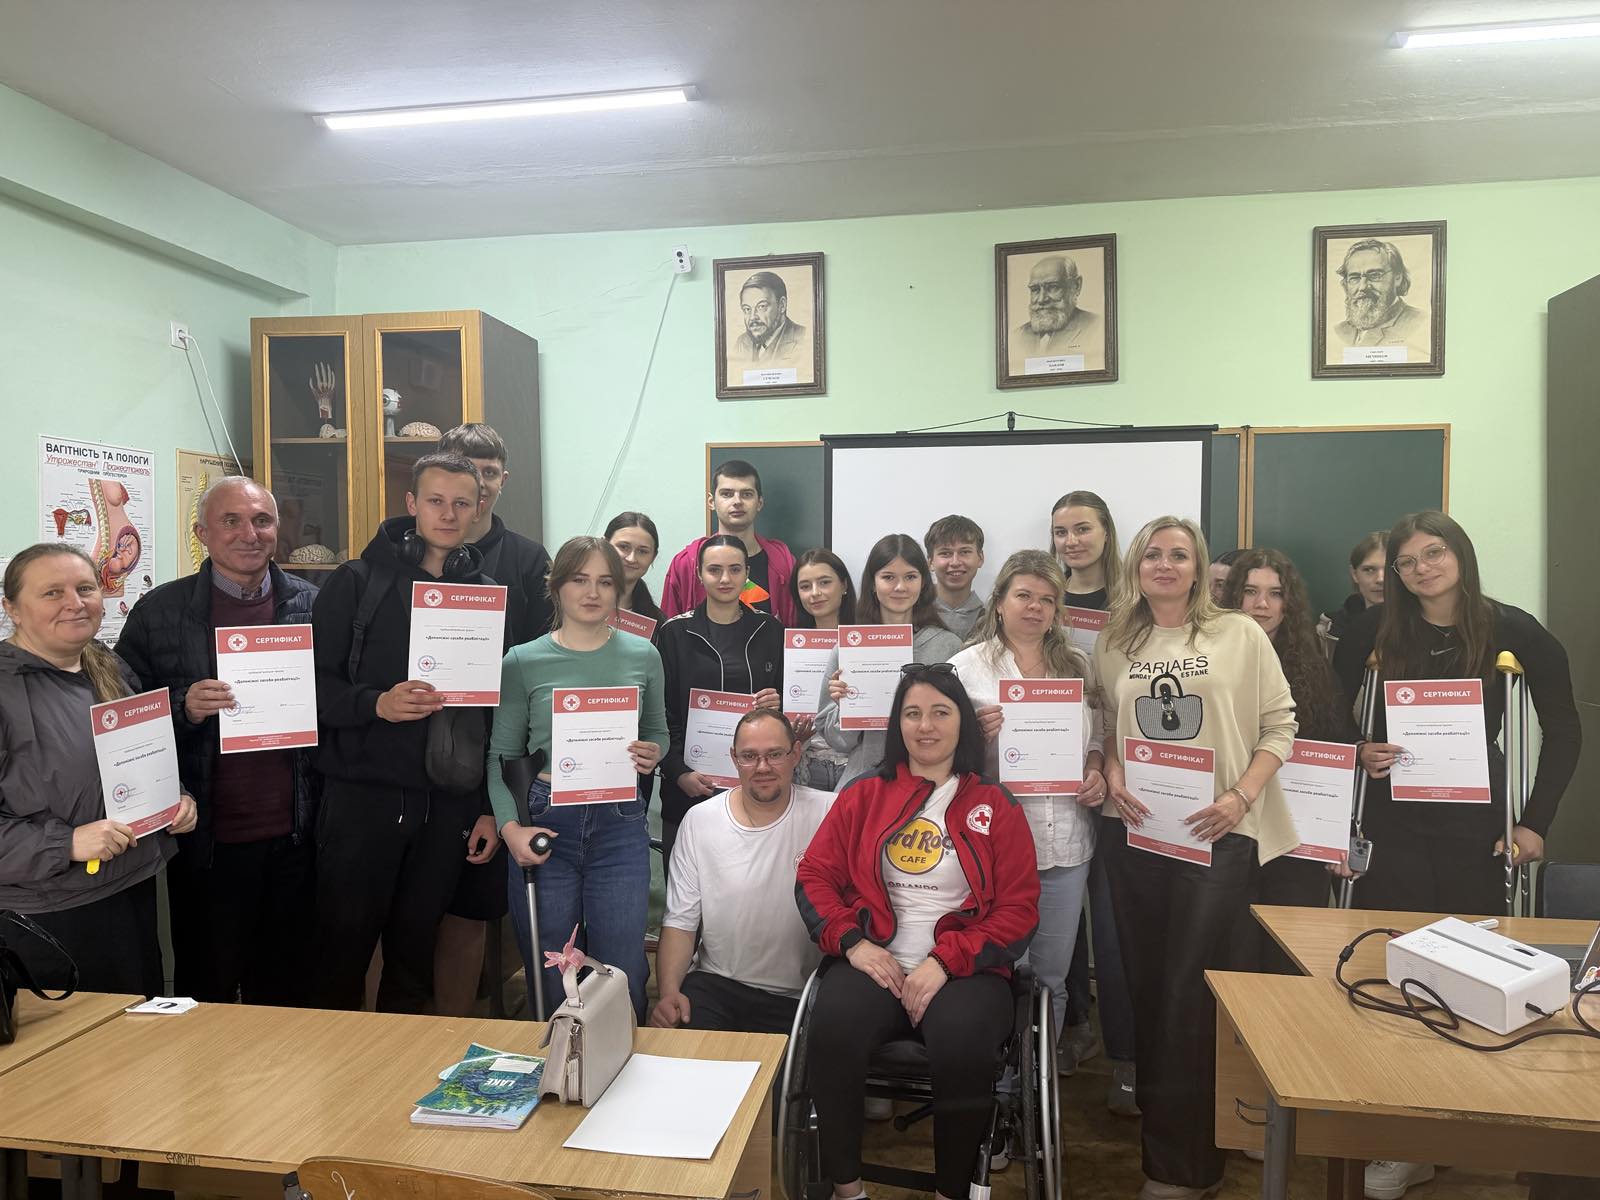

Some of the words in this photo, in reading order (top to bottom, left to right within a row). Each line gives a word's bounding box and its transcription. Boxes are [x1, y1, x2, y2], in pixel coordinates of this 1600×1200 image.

[46, 443, 100, 459] ВАГІТНІСТЬ
[102, 450, 114, 460] ТА
[116, 453, 149, 466] ПОЛОГИ
[450, 594, 496, 602] СЕРТИФІКАТ
[1064, 616, 1100, 624] РТИФІКАТ
[256, 636, 302, 644] СЕРТИФІКАТ
[1129, 656, 1208, 674] PARIAES
[1180, 668, 1208, 678] ESTANE
[1423, 690, 1472, 698] СЕРТИФІКАТ
[587, 697, 629, 705] СЕРТИФІКАТ
[716, 699, 749, 708] СЕРТИФІКАТ
[124, 702, 162, 718] СЕРТИФІКАТ
[1160, 752, 1205, 764] СЕРТИФІКАТ
[1300, 750, 1345, 761] СЕРТИФІКАТ
[917, 830, 955, 854] Roc
[888, 881, 938, 890] ORLANDO
[484, 1078, 516, 1087] LAKE
